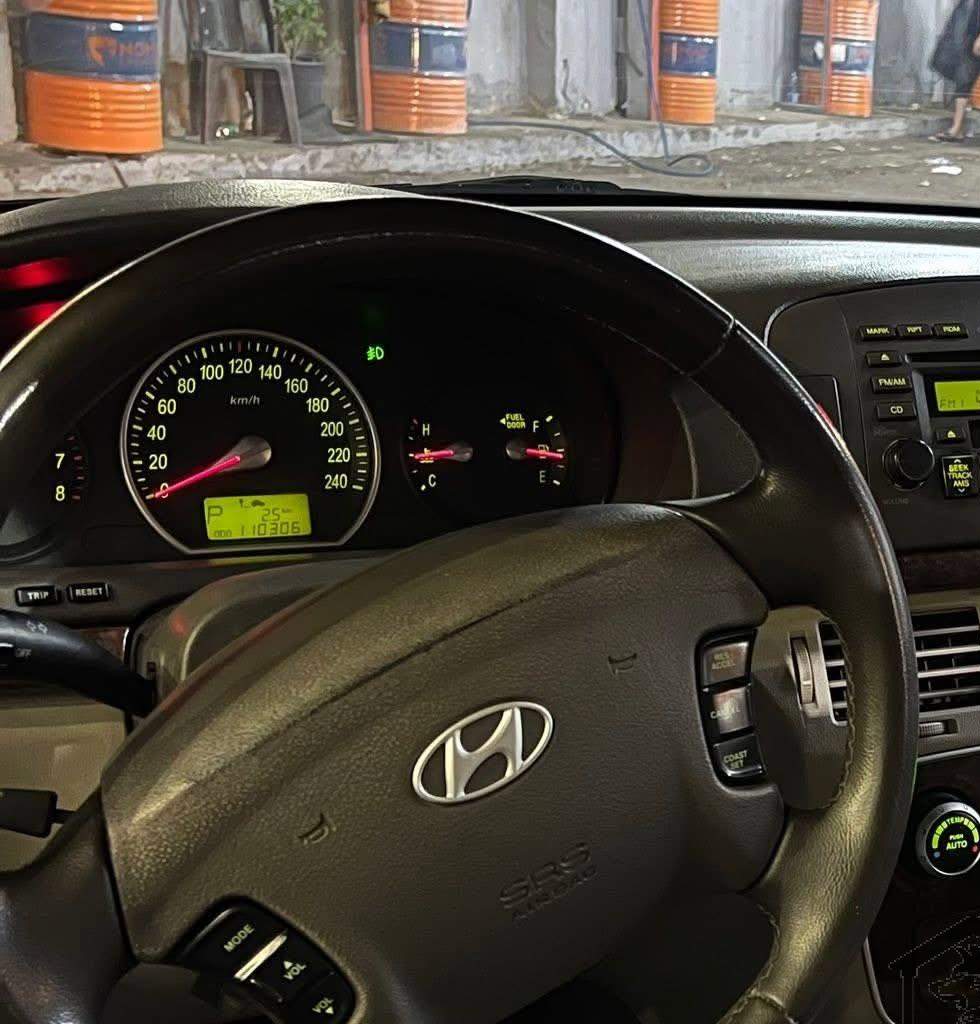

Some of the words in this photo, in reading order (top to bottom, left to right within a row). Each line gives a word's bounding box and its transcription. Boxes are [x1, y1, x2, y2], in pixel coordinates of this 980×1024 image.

[200, 364, 224, 379] 100
[228, 359, 252, 374] 120
[258, 364, 282, 379] 140
[177, 378, 196, 393] 80
[284, 378, 309, 394] 160
[157, 399, 177, 414] 60
[230, 395, 260, 406] km/h
[306, 398, 329, 413] 180
[890, 405, 904, 414] CD
[321, 422, 344, 437] 200
[422, 424, 430, 436] H
[506, 421, 526, 429] DOOR
[533, 420, 540, 432] F
[147, 426, 166, 441] 40
[55, 453, 65, 469] 7
[149, 453, 168, 470] 20
[328, 448, 350, 463] 220
[324, 474, 348, 489] 240
[428, 474, 436, 487] C
[539, 470, 546, 483] E
[948, 471, 973, 480] TRACK
[55, 485, 65, 501] 8
[207, 505, 223, 525] P
[262, 507, 280, 522] 25
[241, 521, 300, 537] 110306
[27, 591, 49, 600] TRIP
[75, 587, 103, 597] RESET
[723, 750, 748, 764] COAST
[946, 840, 968, 851] AUTO
[223, 923, 255, 952] MODE
[283, 961, 307, 981] VOL
[312, 996, 334, 1014] VOL
